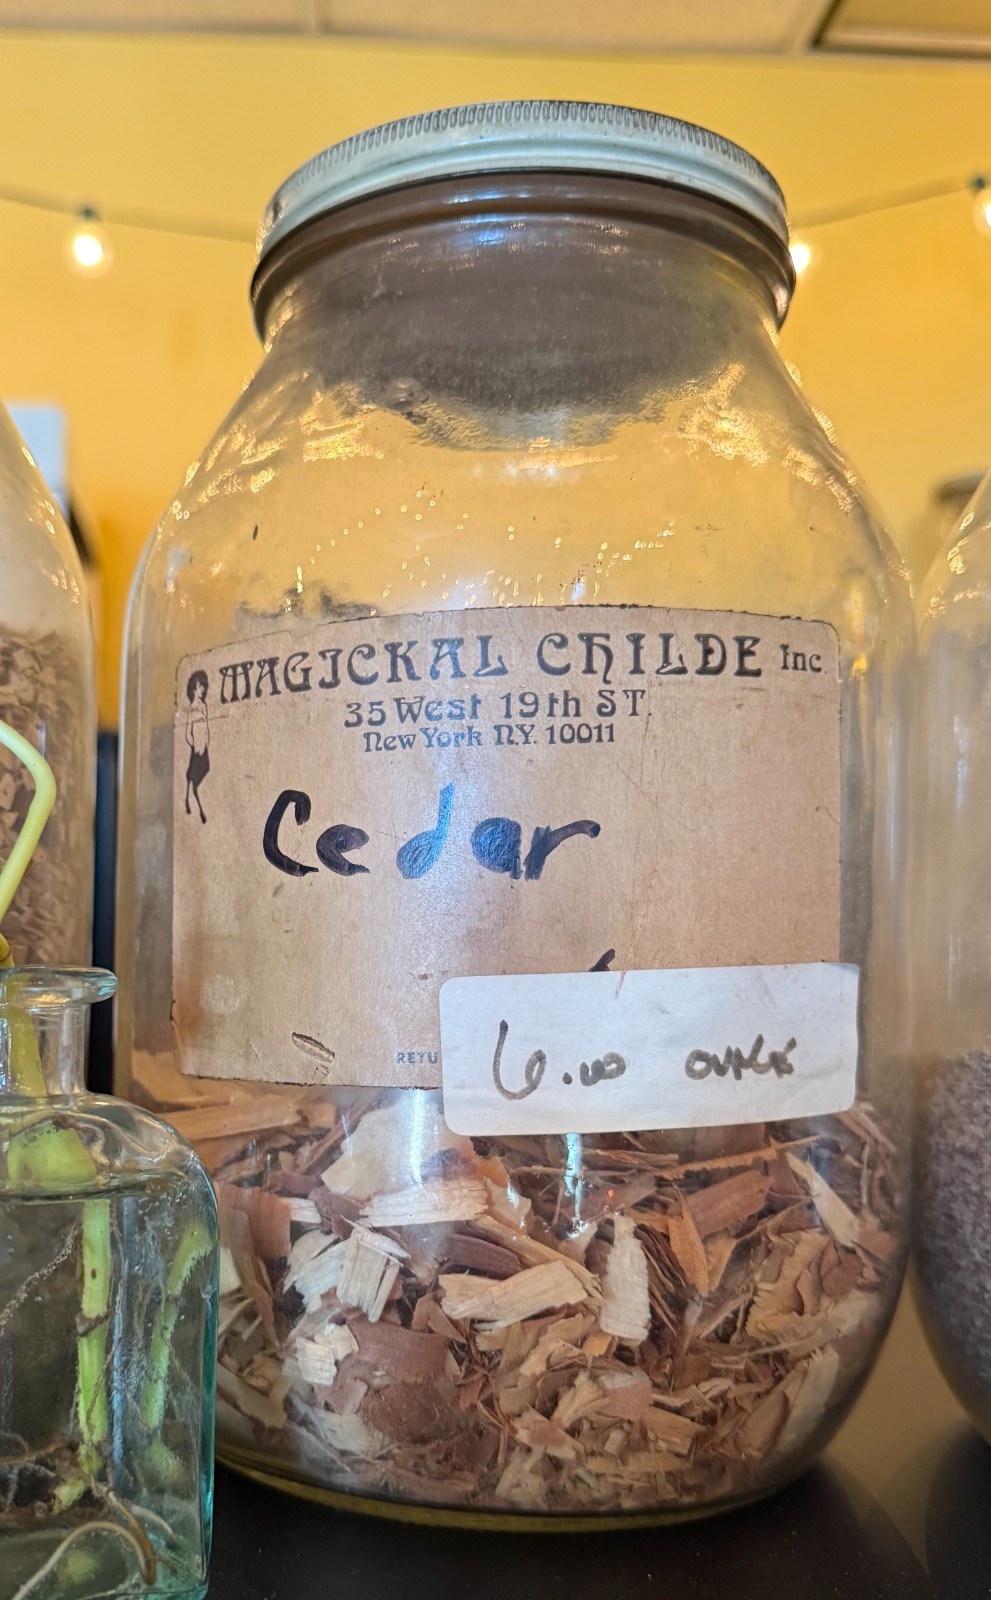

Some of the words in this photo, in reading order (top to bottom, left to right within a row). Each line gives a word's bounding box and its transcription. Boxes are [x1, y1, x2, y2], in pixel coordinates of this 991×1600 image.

[219, 635, 509, 705] MAGICKAL
[536, 632, 762, 685] CHILDE
[344, 700, 387, 728] 35
[393, 693, 482, 724] West
[500, 689, 582, 719] 19th
[363, 731, 417, 753] New
[420, 726, 483, 748] York
[545, 723, 615, 745] 10011
[263, 782, 601, 880] Cedar
[396, 1051, 439, 1065] RETU
